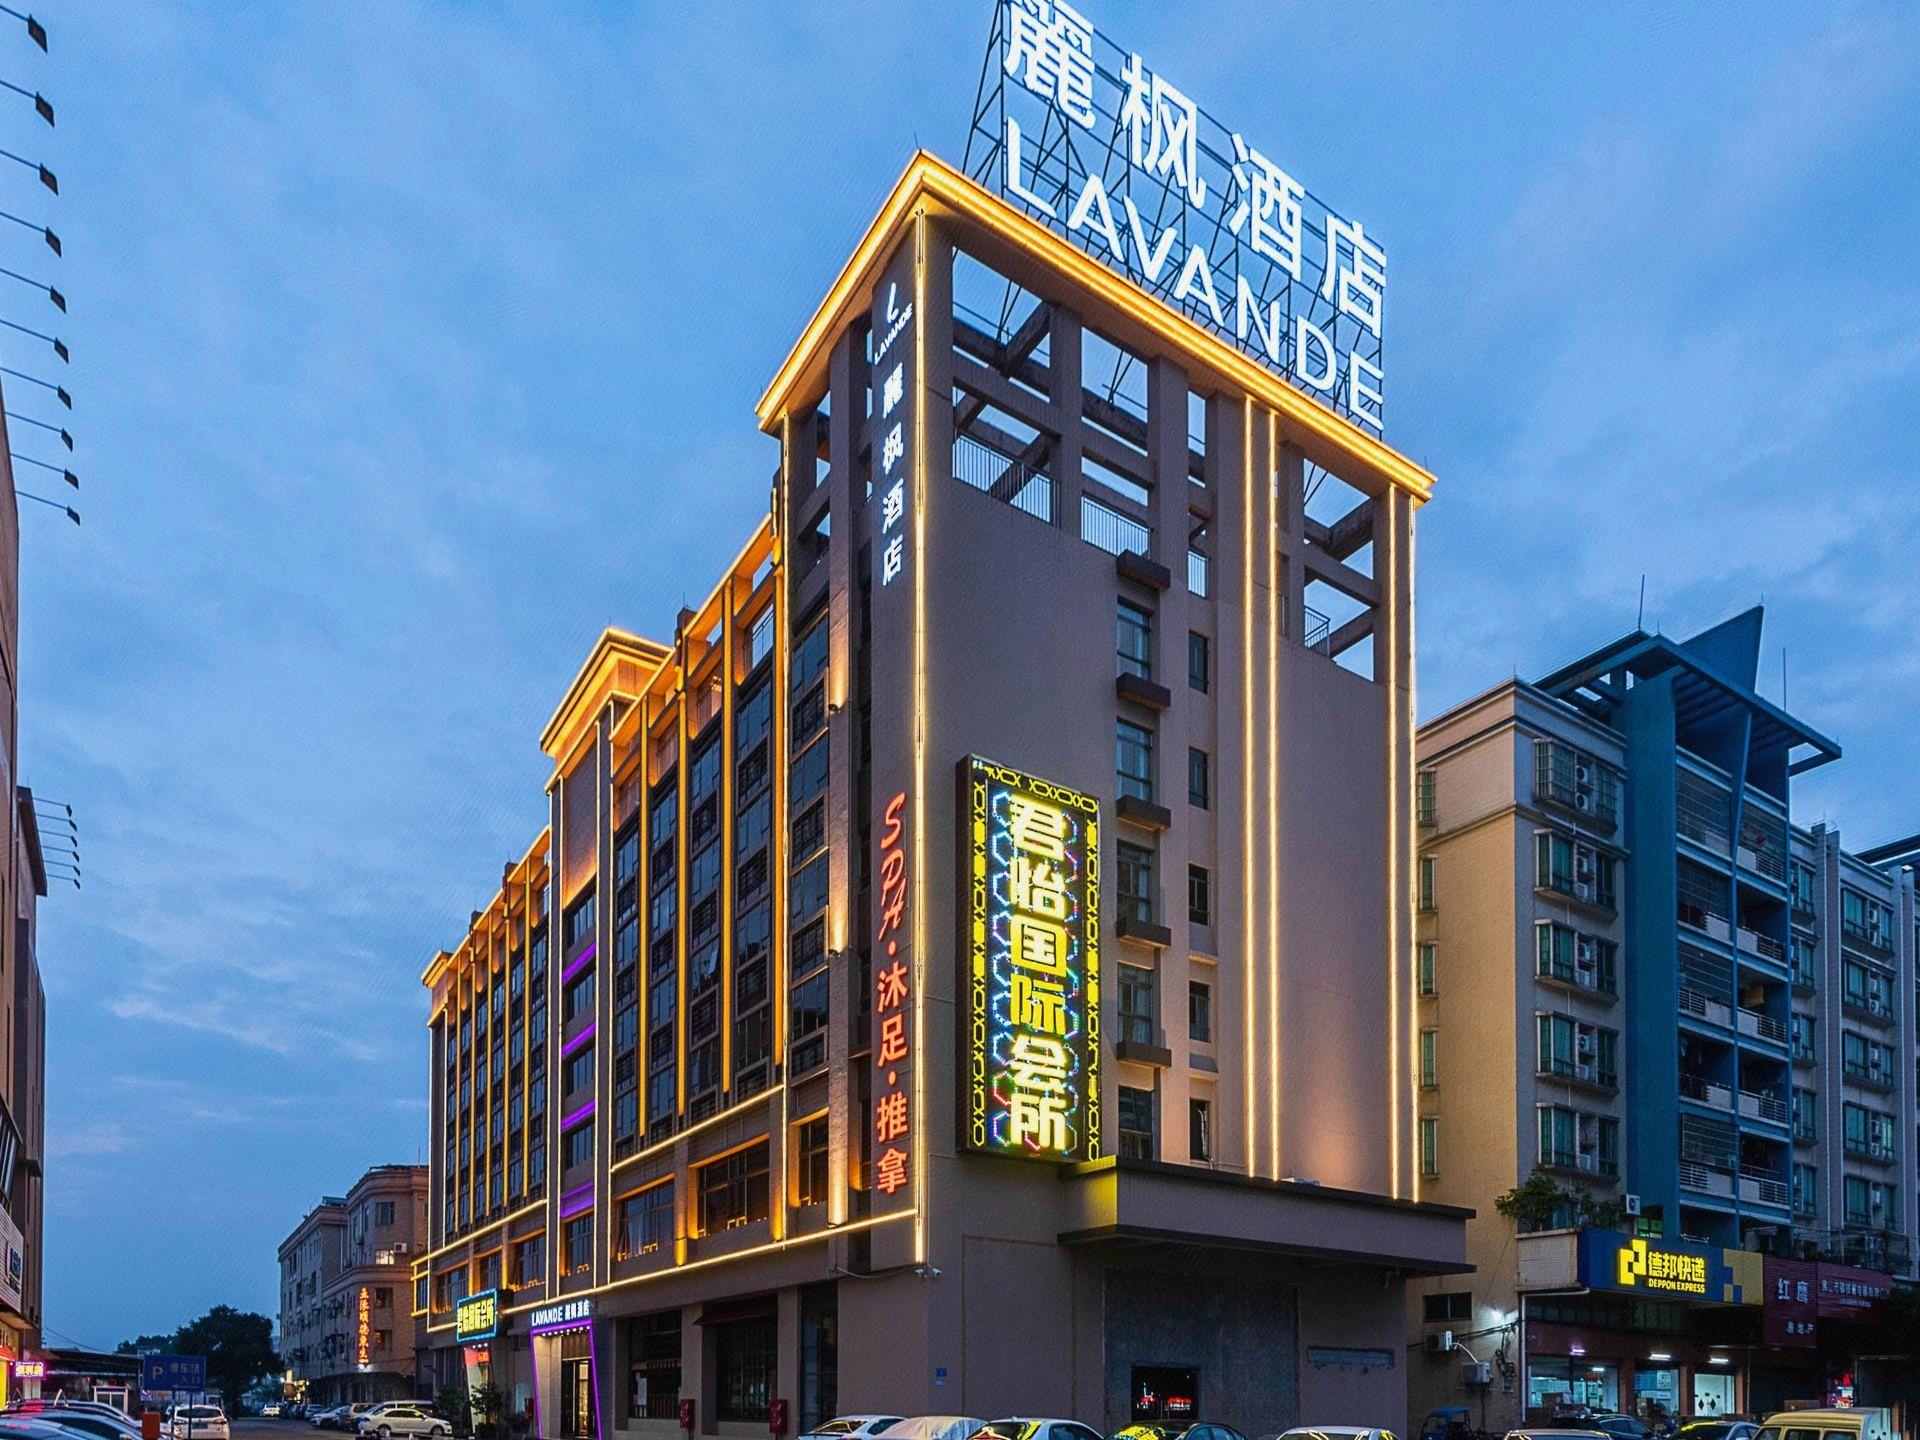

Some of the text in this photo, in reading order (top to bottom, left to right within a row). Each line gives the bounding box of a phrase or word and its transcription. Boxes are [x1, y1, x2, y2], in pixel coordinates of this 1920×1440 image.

[1007, 116, 1384, 431] LAVANDE
[873, 302, 914, 366] LAVANDE
[1009, 794, 1068, 1149] 君怡国际会所
[1648, 1251, 1706, 1284] 德邦快递
[1648, 1277, 1706, 1295] DEPPON EXPRESS
[531, 1306, 563, 1327] LAVANDE
